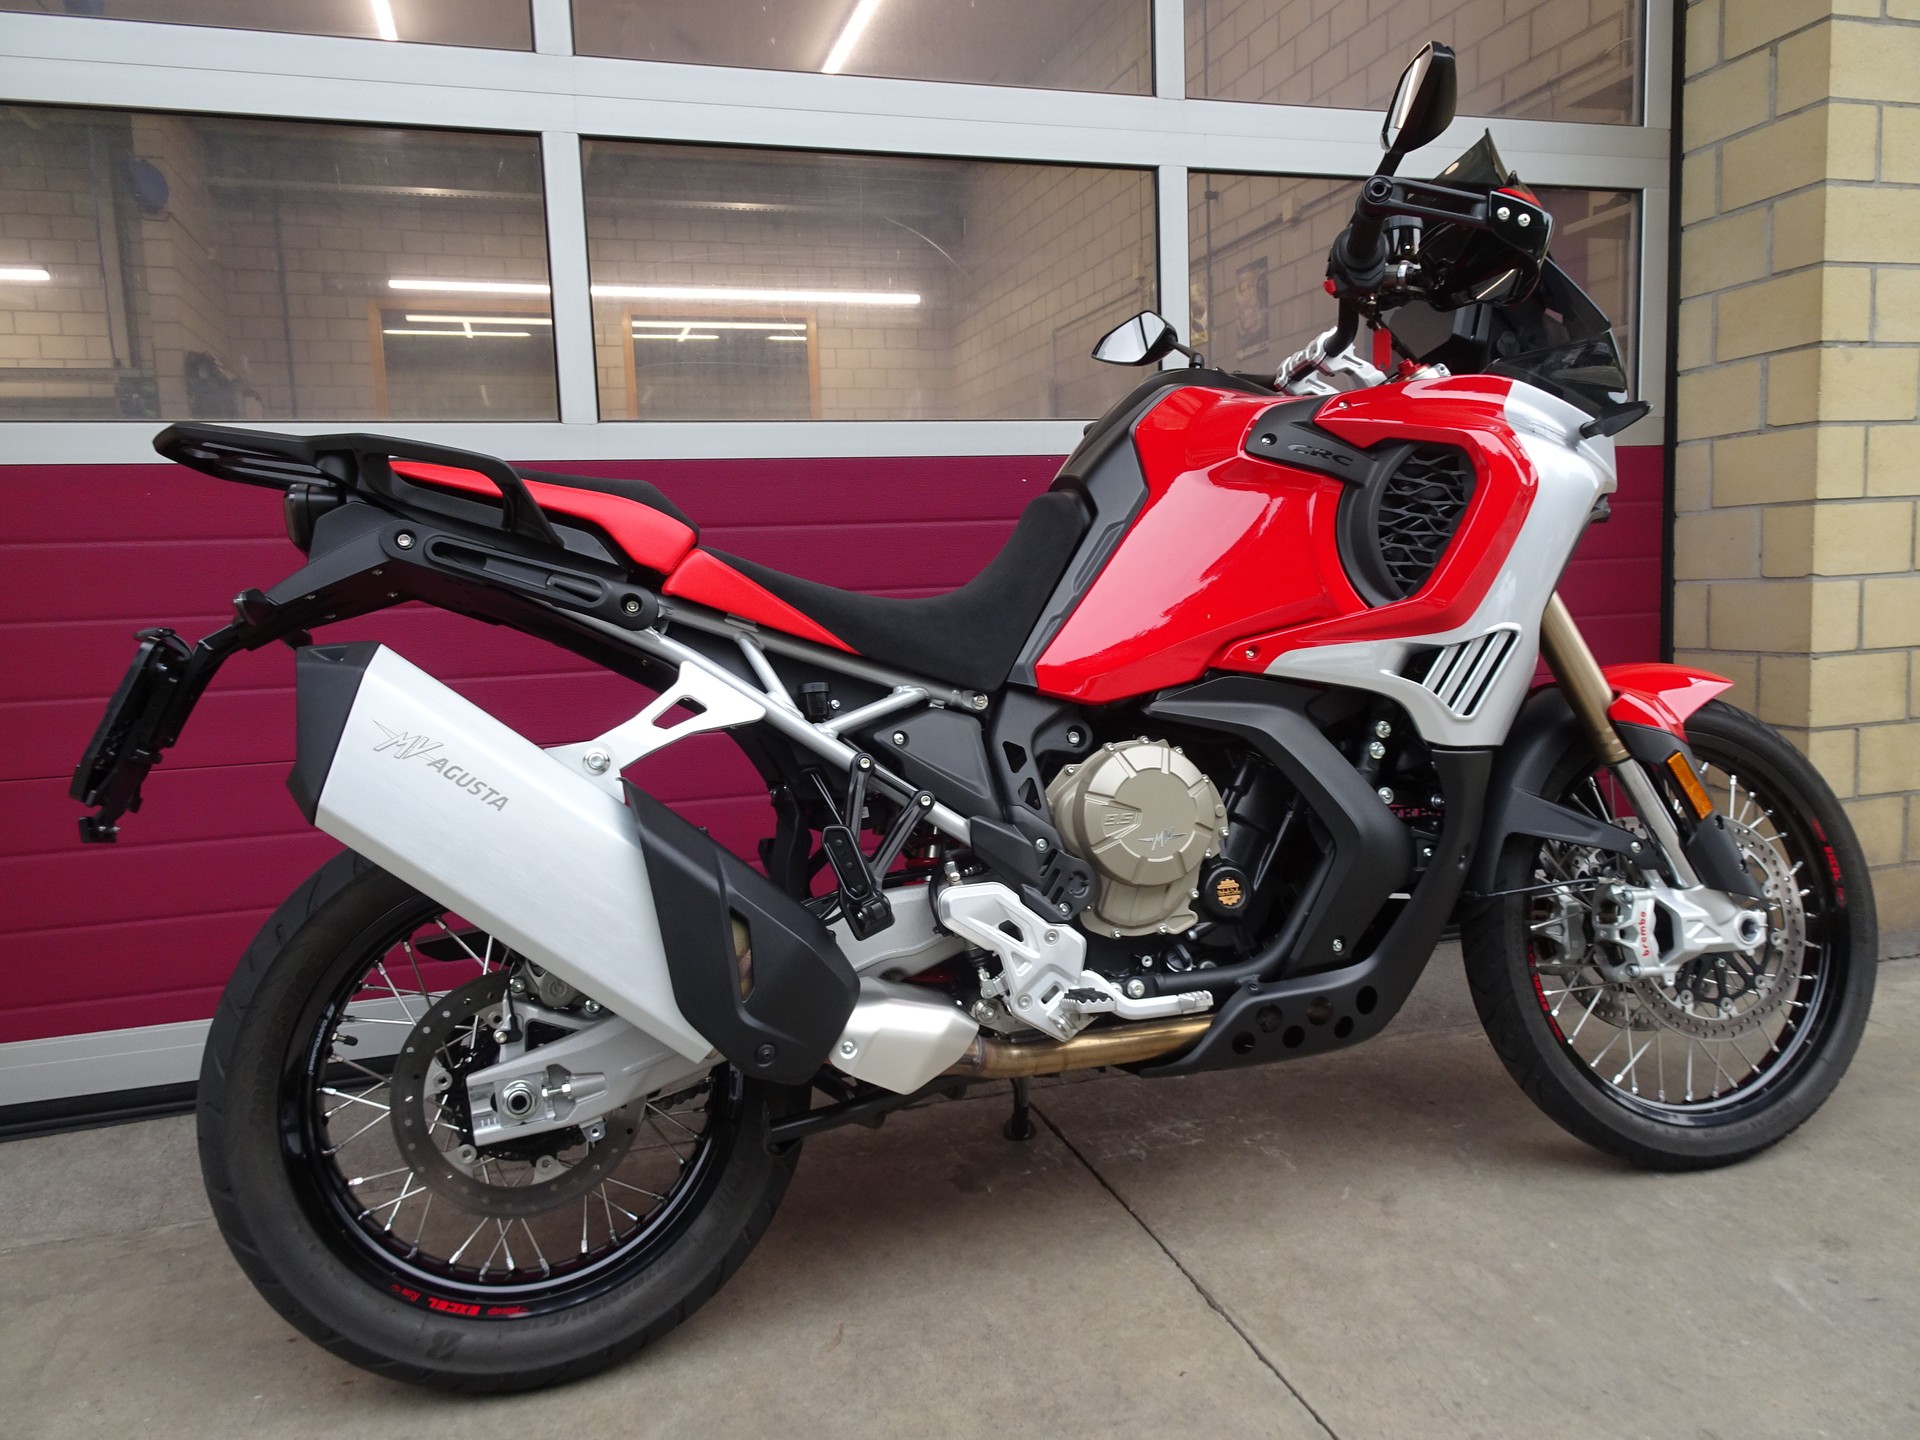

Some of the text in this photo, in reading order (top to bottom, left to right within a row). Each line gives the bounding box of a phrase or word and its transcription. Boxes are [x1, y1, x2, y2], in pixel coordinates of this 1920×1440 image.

[1287, 444, 1354, 467] CRC
[426, 757, 510, 812] AGUSTA
[1638, 911, 1651, 957] brembo
[428, 1296, 482, 1317] EXCEL
